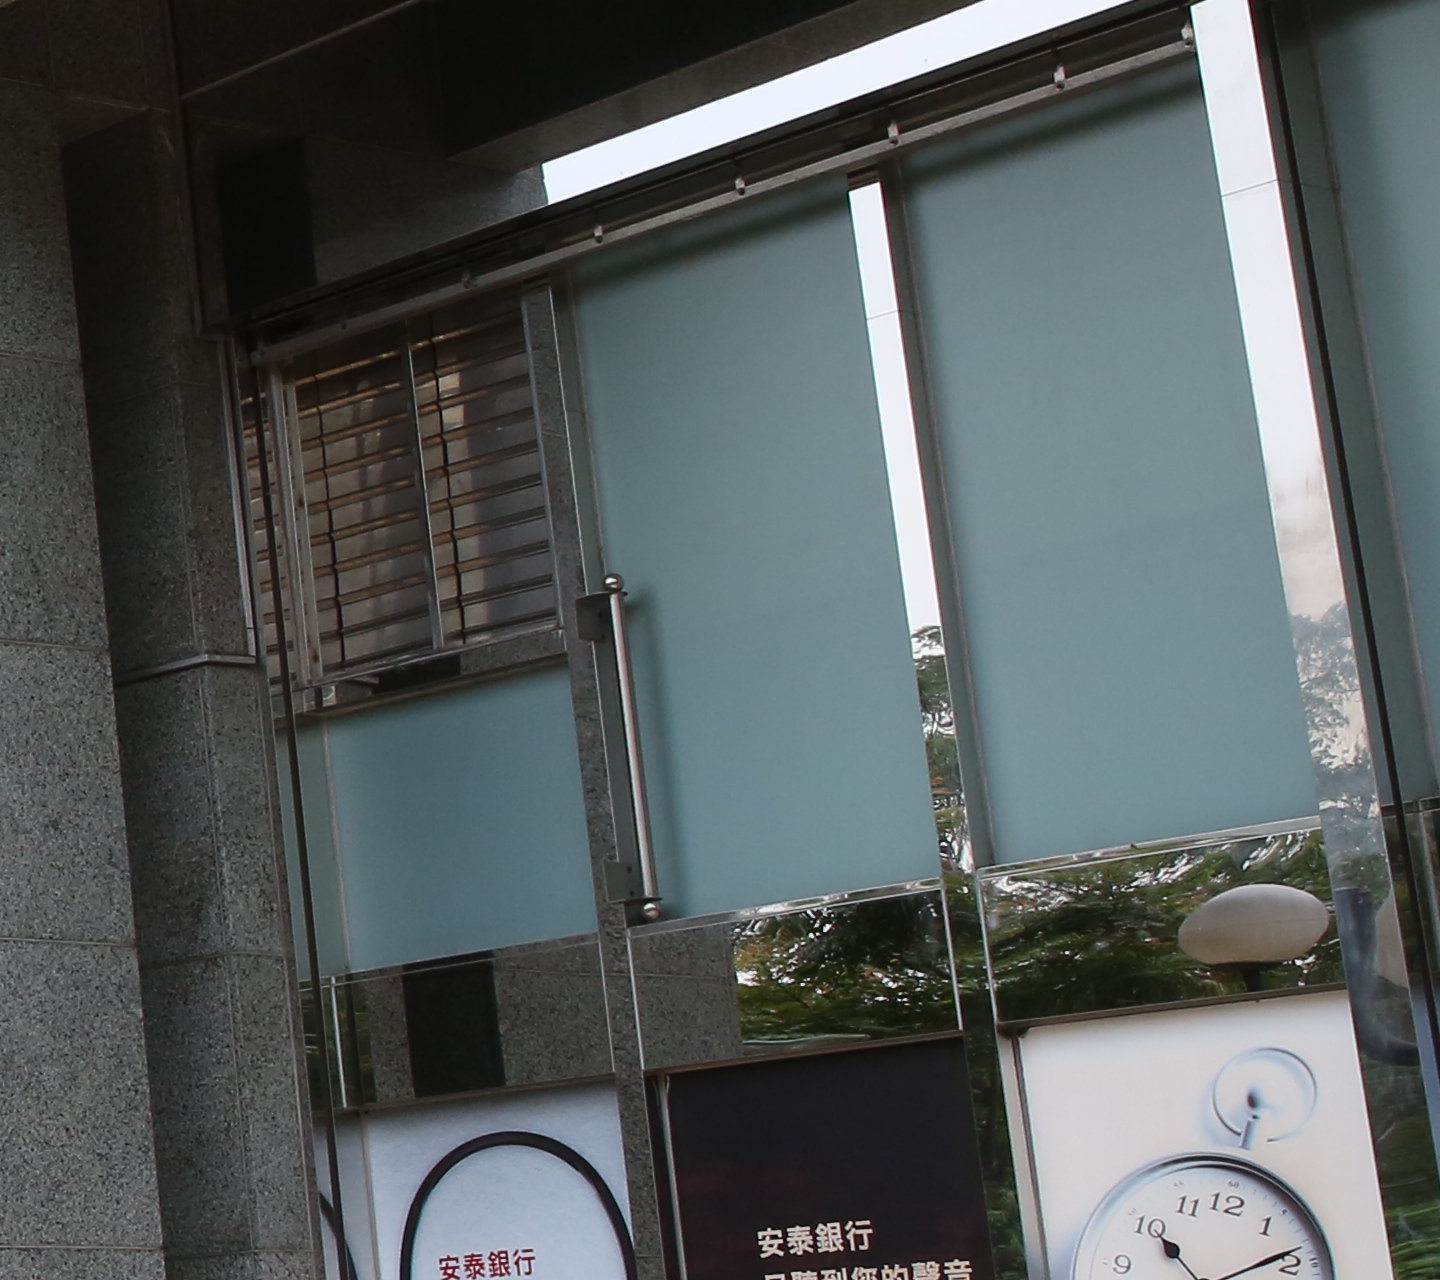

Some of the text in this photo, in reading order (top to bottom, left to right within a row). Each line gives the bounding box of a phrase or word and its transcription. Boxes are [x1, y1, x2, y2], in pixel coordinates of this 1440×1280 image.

[1175, 1195, 1200, 1218] 11
[1209, 1192, 1245, 1217] 12
[1133, 1215, 1166, 1238] 10
[1259, 1216, 1272, 1237] 1
[756, 1219, 874, 1260] 安泰銀行
[1113, 1254, 1132, 1275] 9
[1278, 1254, 1301, 1276] 2
